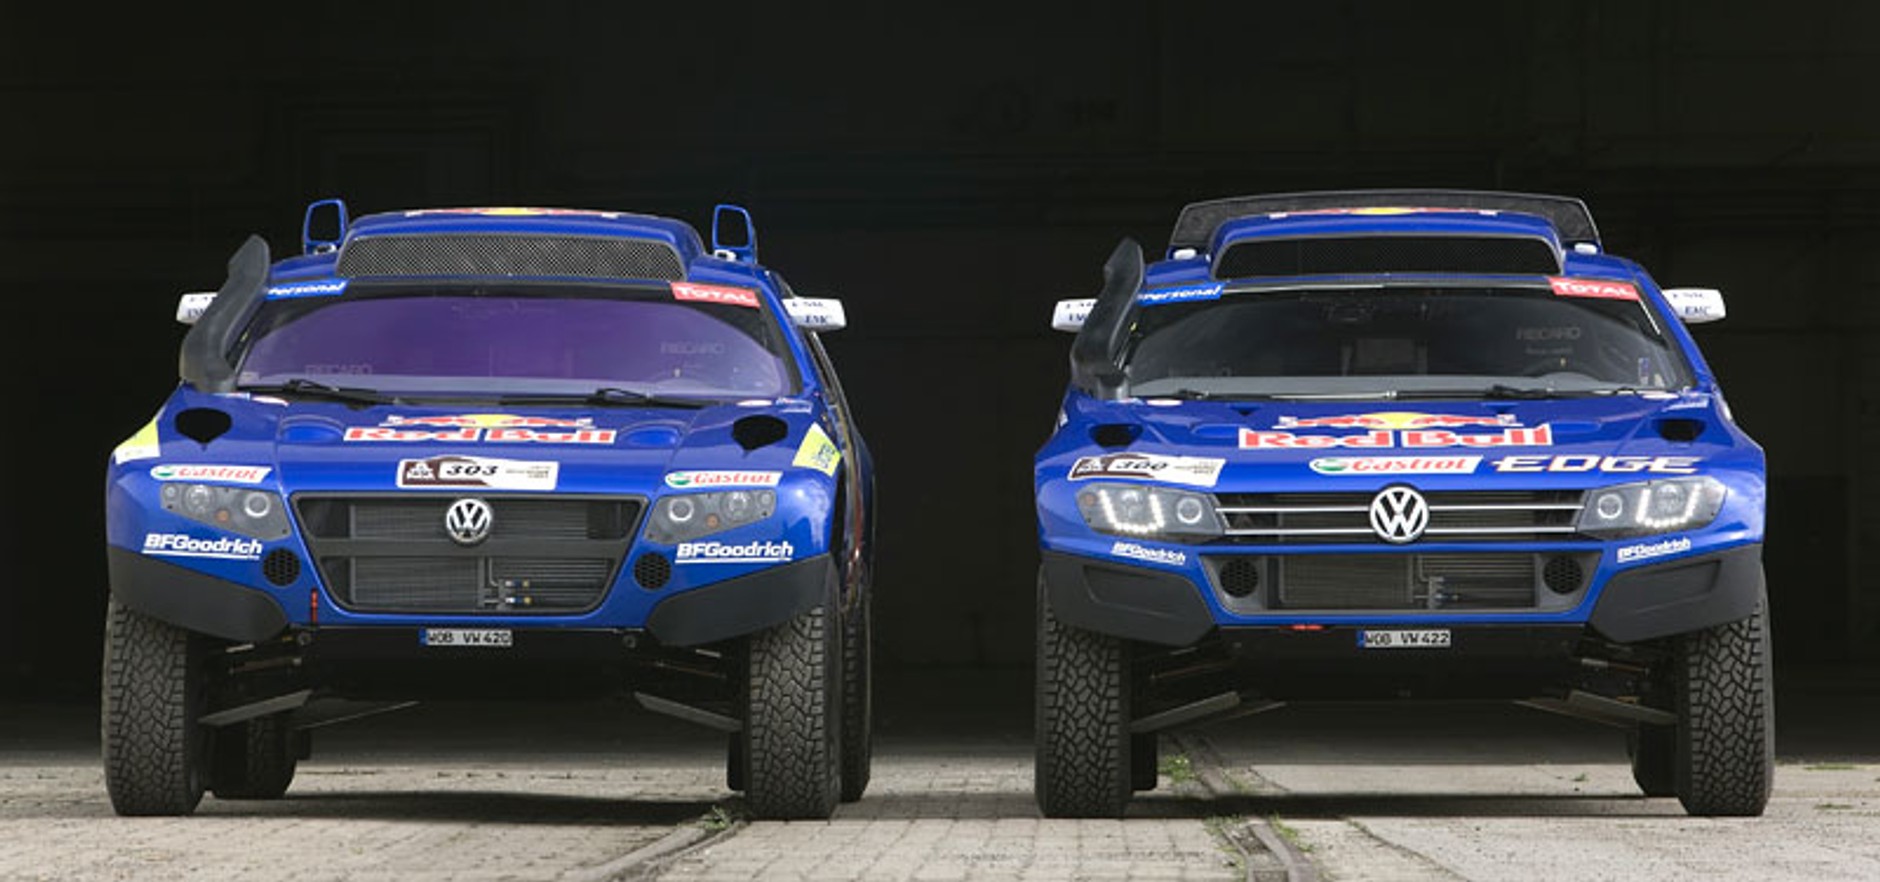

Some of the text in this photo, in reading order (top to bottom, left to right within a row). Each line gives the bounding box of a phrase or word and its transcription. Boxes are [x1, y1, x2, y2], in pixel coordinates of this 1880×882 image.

[676, 286, 755, 303] TOTAL
[1556, 283, 1634, 297] TOTAL
[346, 427, 615, 444] Red Bull
[1242, 424, 1550, 447] Red Bull
[446, 464, 499, 476] 303
[1352, 458, 1465, 472] Castrol
[1492, 455, 1702, 473] EDGE
[694, 472, 772, 484] Castrol
[144, 534, 262, 557] BFGoodrich
[676, 541, 793, 559] BFGoodrich
[1421, 632, 1449, 645] 422
